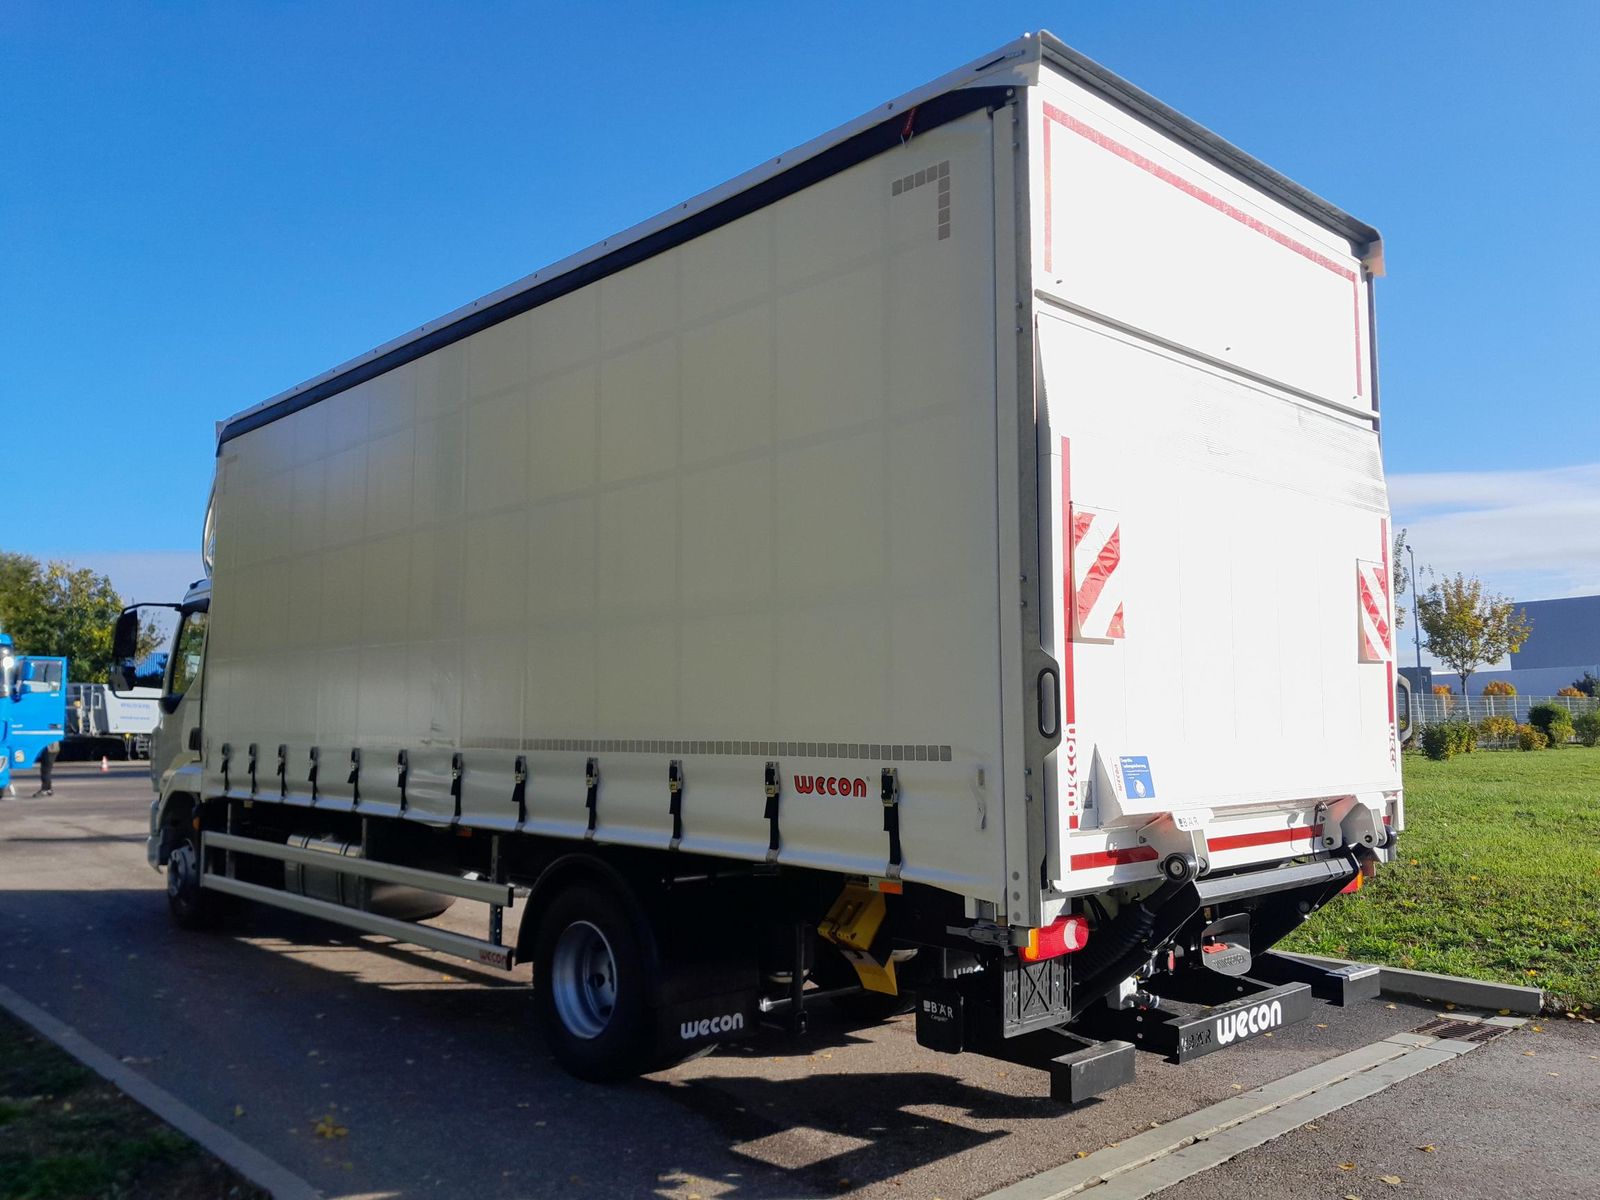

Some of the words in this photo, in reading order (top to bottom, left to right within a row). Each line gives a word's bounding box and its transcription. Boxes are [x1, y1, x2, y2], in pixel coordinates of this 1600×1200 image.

[794, 775, 867, 798] wecon
[930, 1000, 954, 1019] BÄR
[1216, 1000, 1282, 1044] wecon
[680, 1012, 744, 1039] wecon
